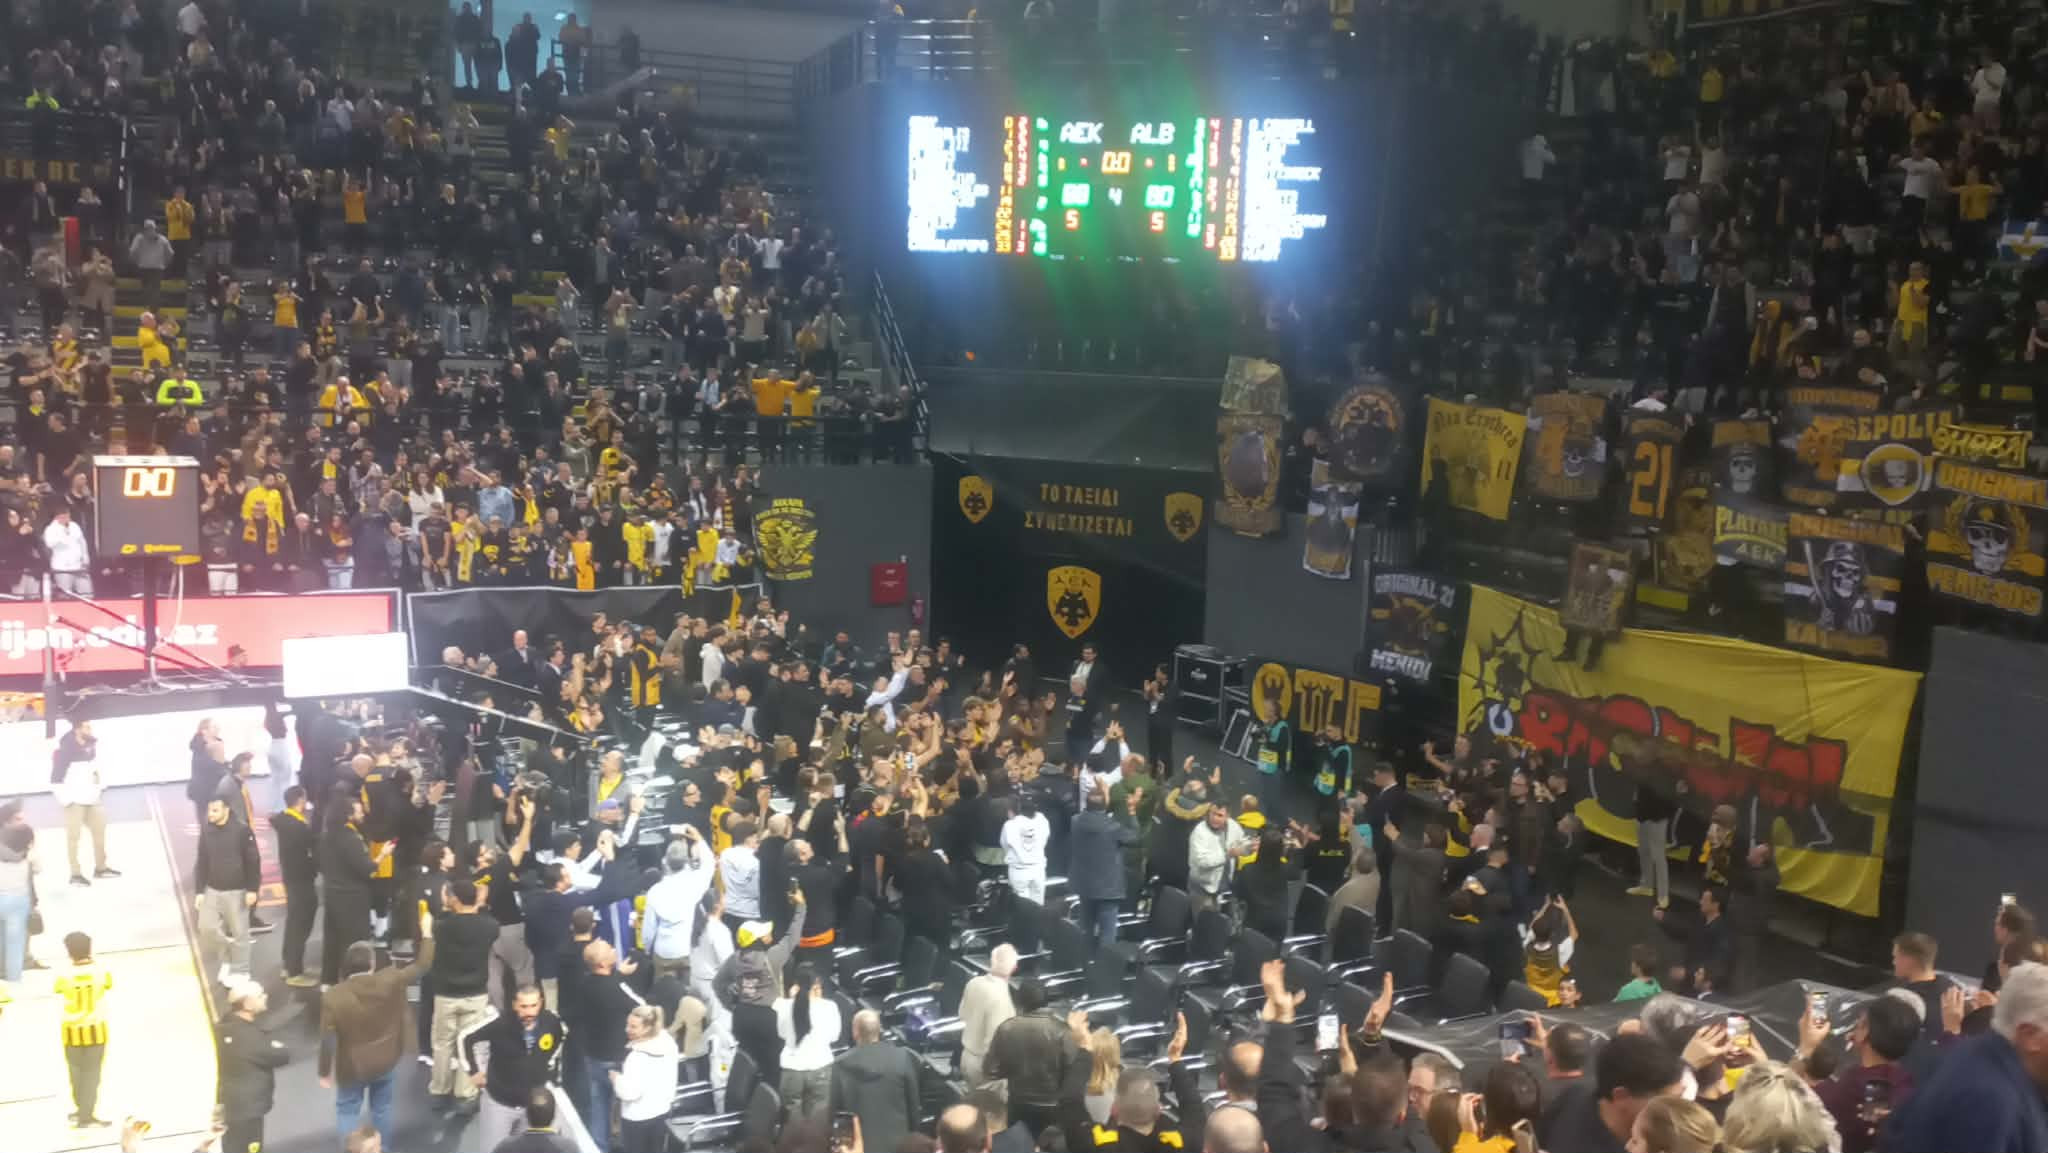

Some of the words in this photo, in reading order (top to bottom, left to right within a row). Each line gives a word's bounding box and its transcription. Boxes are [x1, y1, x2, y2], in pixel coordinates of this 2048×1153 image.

[1060, 122, 1103, 143] AEK
[1130, 123, 1175, 144] ALB
[1109, 187, 1122, 205] 4
[1066, 210, 1079, 230] 5
[1151, 212, 1164, 232] 5
[1630, 440, 1673, 520] 21
[1375, 574, 1438, 599] ORIGINAL
